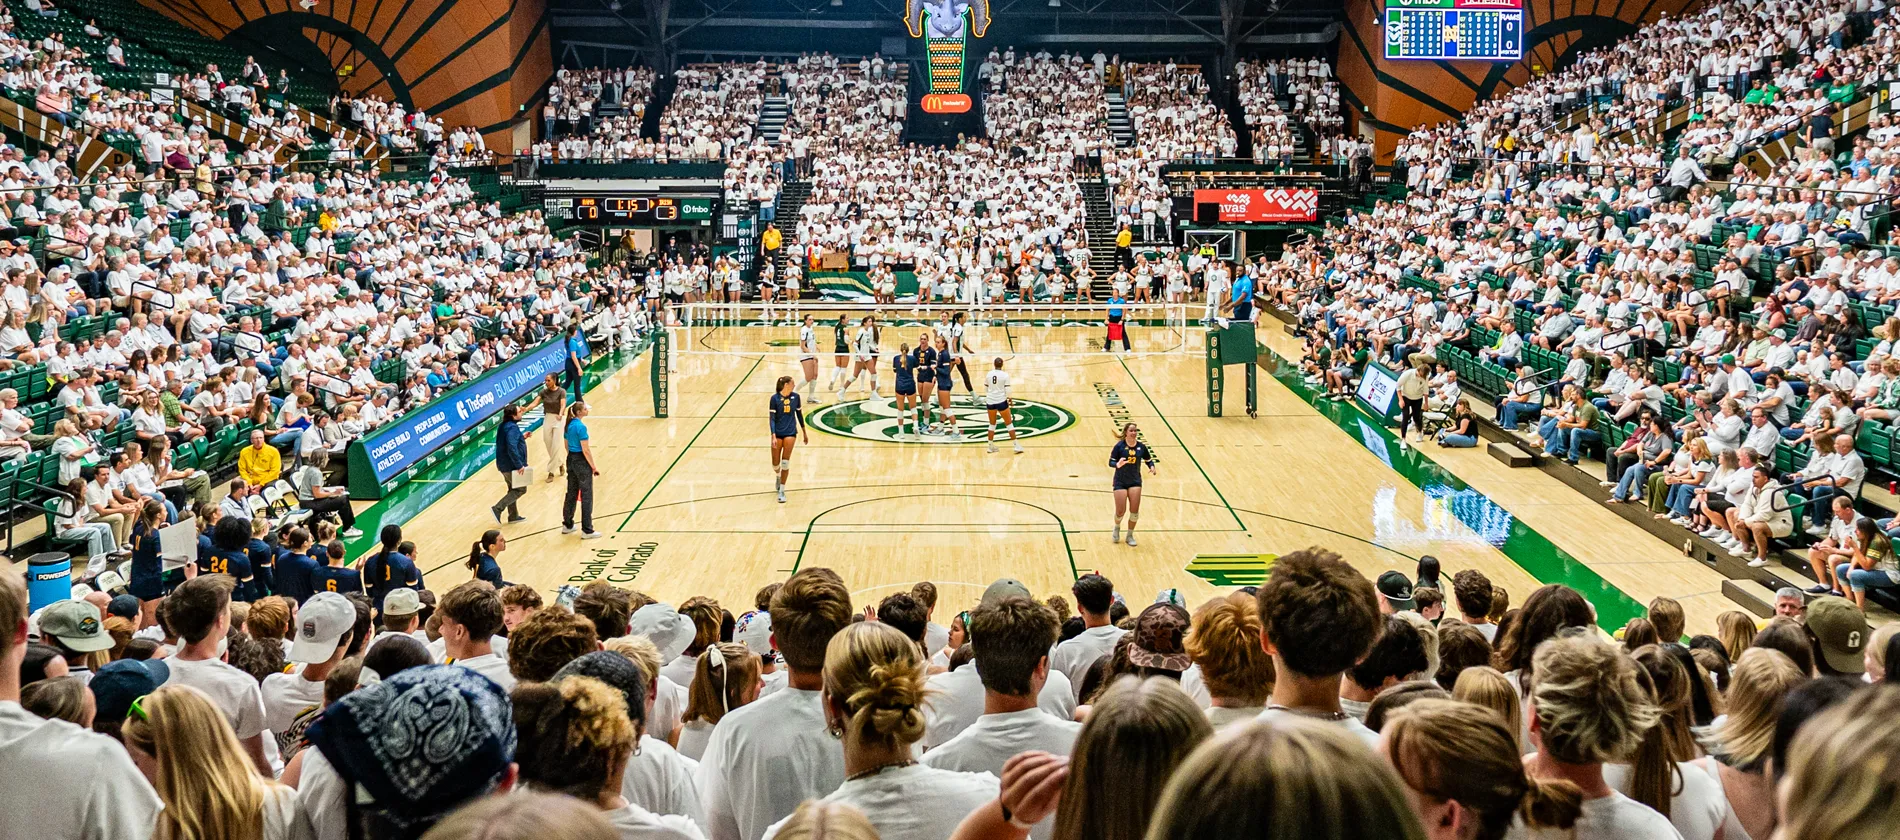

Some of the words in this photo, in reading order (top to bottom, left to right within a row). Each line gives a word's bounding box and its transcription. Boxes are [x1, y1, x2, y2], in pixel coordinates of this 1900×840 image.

[1506, 22, 1513, 32] 0
[1506, 41, 1512, 49] 0
[1881, 90, 1888, 103] P
[114, 154, 123, 164] D
[1748, 156, 1756, 166] P
[590, 206, 597, 218] 0
[618, 200, 638, 211] 1:15
[668, 207, 675, 218] 3
[1210, 336, 1217, 359] GO
[494, 376, 516, 398] BUILD
[514, 360, 545, 387] AMAZING
[542, 348, 565, 370] THINGS
[992, 375, 997, 384] 8
[1212, 368, 1220, 414] RAMS
[465, 392, 495, 413] TheGroup
[414, 416, 434, 434] PEOPLE
[430, 411, 446, 427] BUILD
[372, 438, 397, 459] COACHES
[395, 431, 411, 446] BUILD
[210, 556, 228, 574] 24
[606, 542, 659, 582] Colorado
[568, 558, 612, 582] Bank
[326, 579, 337, 592] 6
